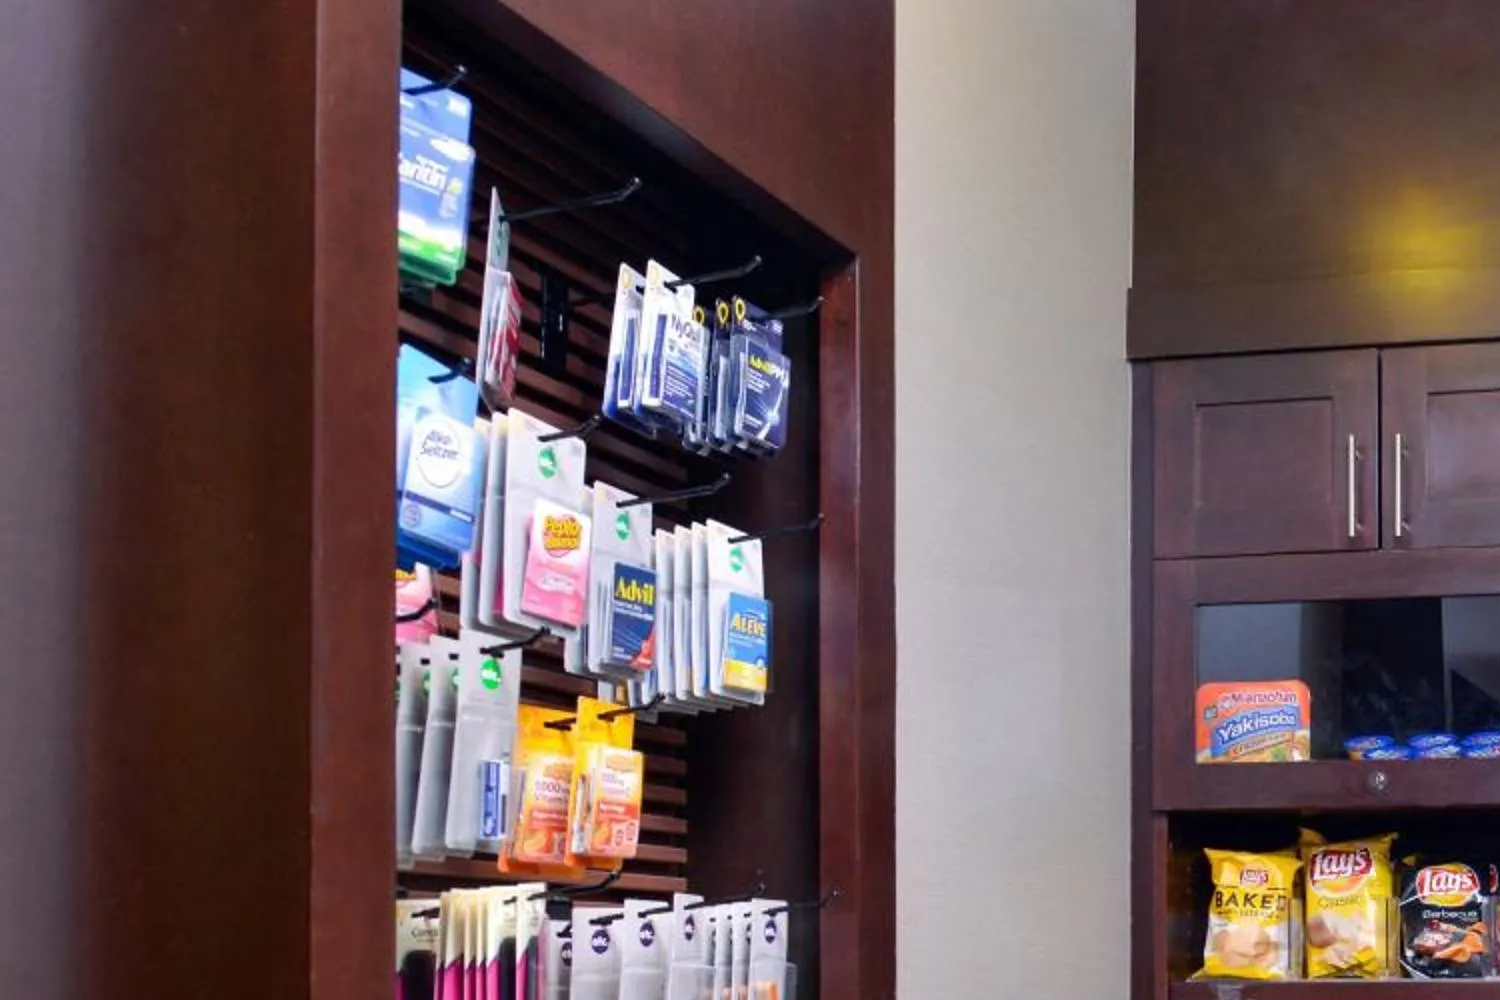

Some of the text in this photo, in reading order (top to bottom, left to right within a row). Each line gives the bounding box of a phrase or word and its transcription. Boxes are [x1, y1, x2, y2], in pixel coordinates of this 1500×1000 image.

[615, 577, 654, 606] Advil
[1217, 713, 1297, 744] Yakisoba
[1214, 890, 1288, 912] BAKED
